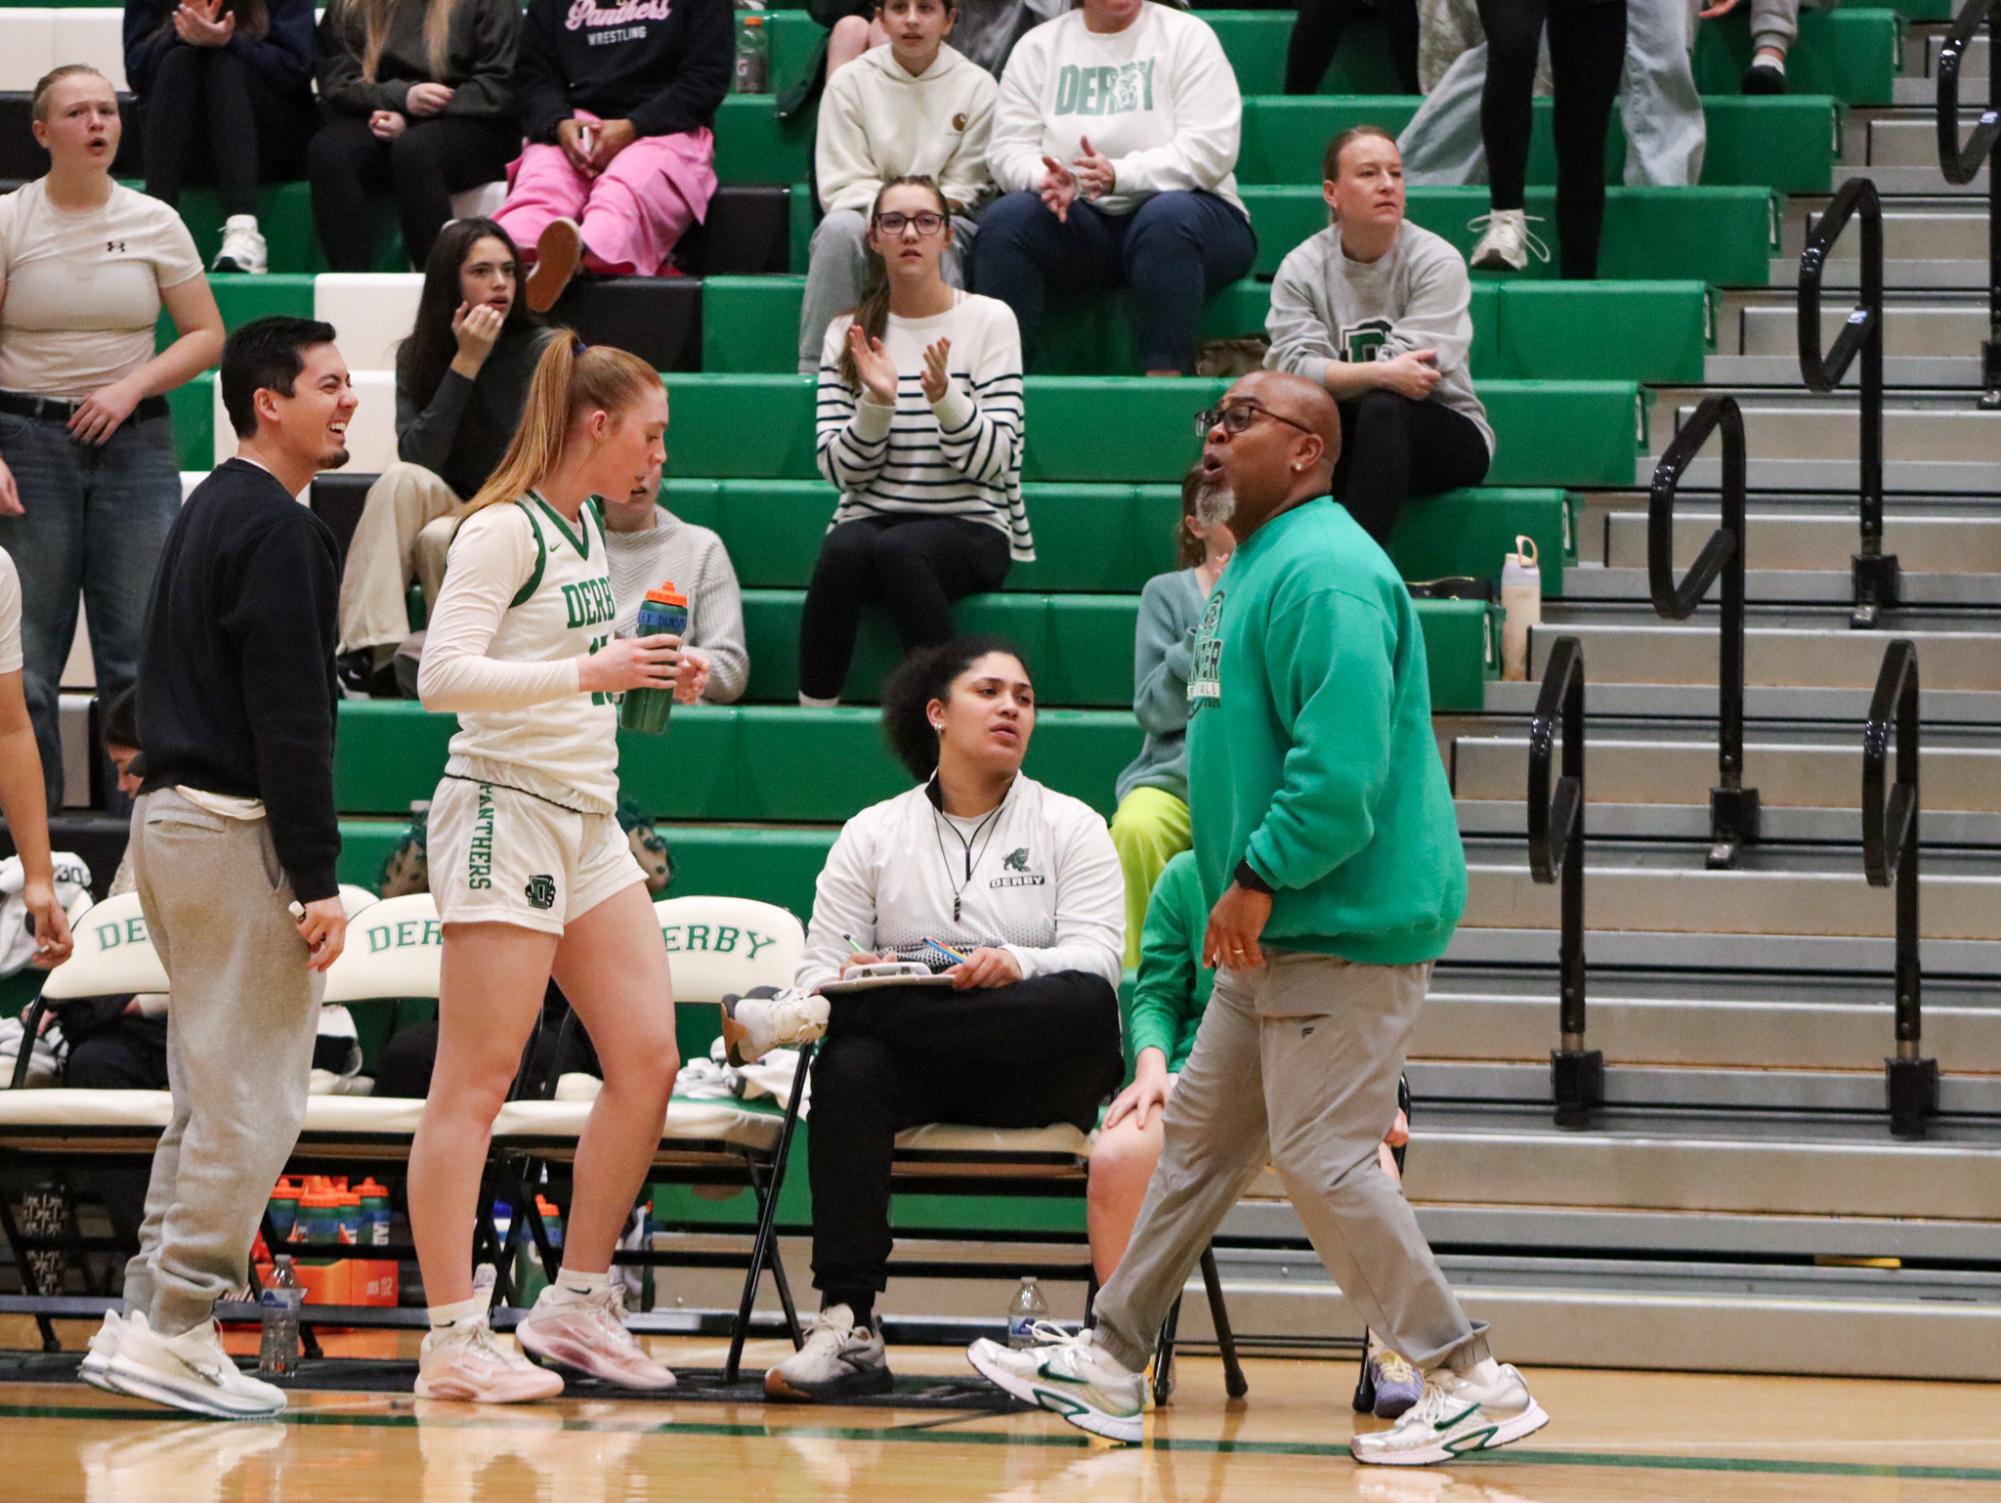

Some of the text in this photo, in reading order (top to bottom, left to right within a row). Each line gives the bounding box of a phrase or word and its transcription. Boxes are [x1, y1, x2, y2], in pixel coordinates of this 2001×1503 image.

[587, 26, 647, 46] WRESTLING
[561, 576, 616, 629] DERB
[367, 920, 443, 953] DER
[662, 925, 776, 959] ERBY
